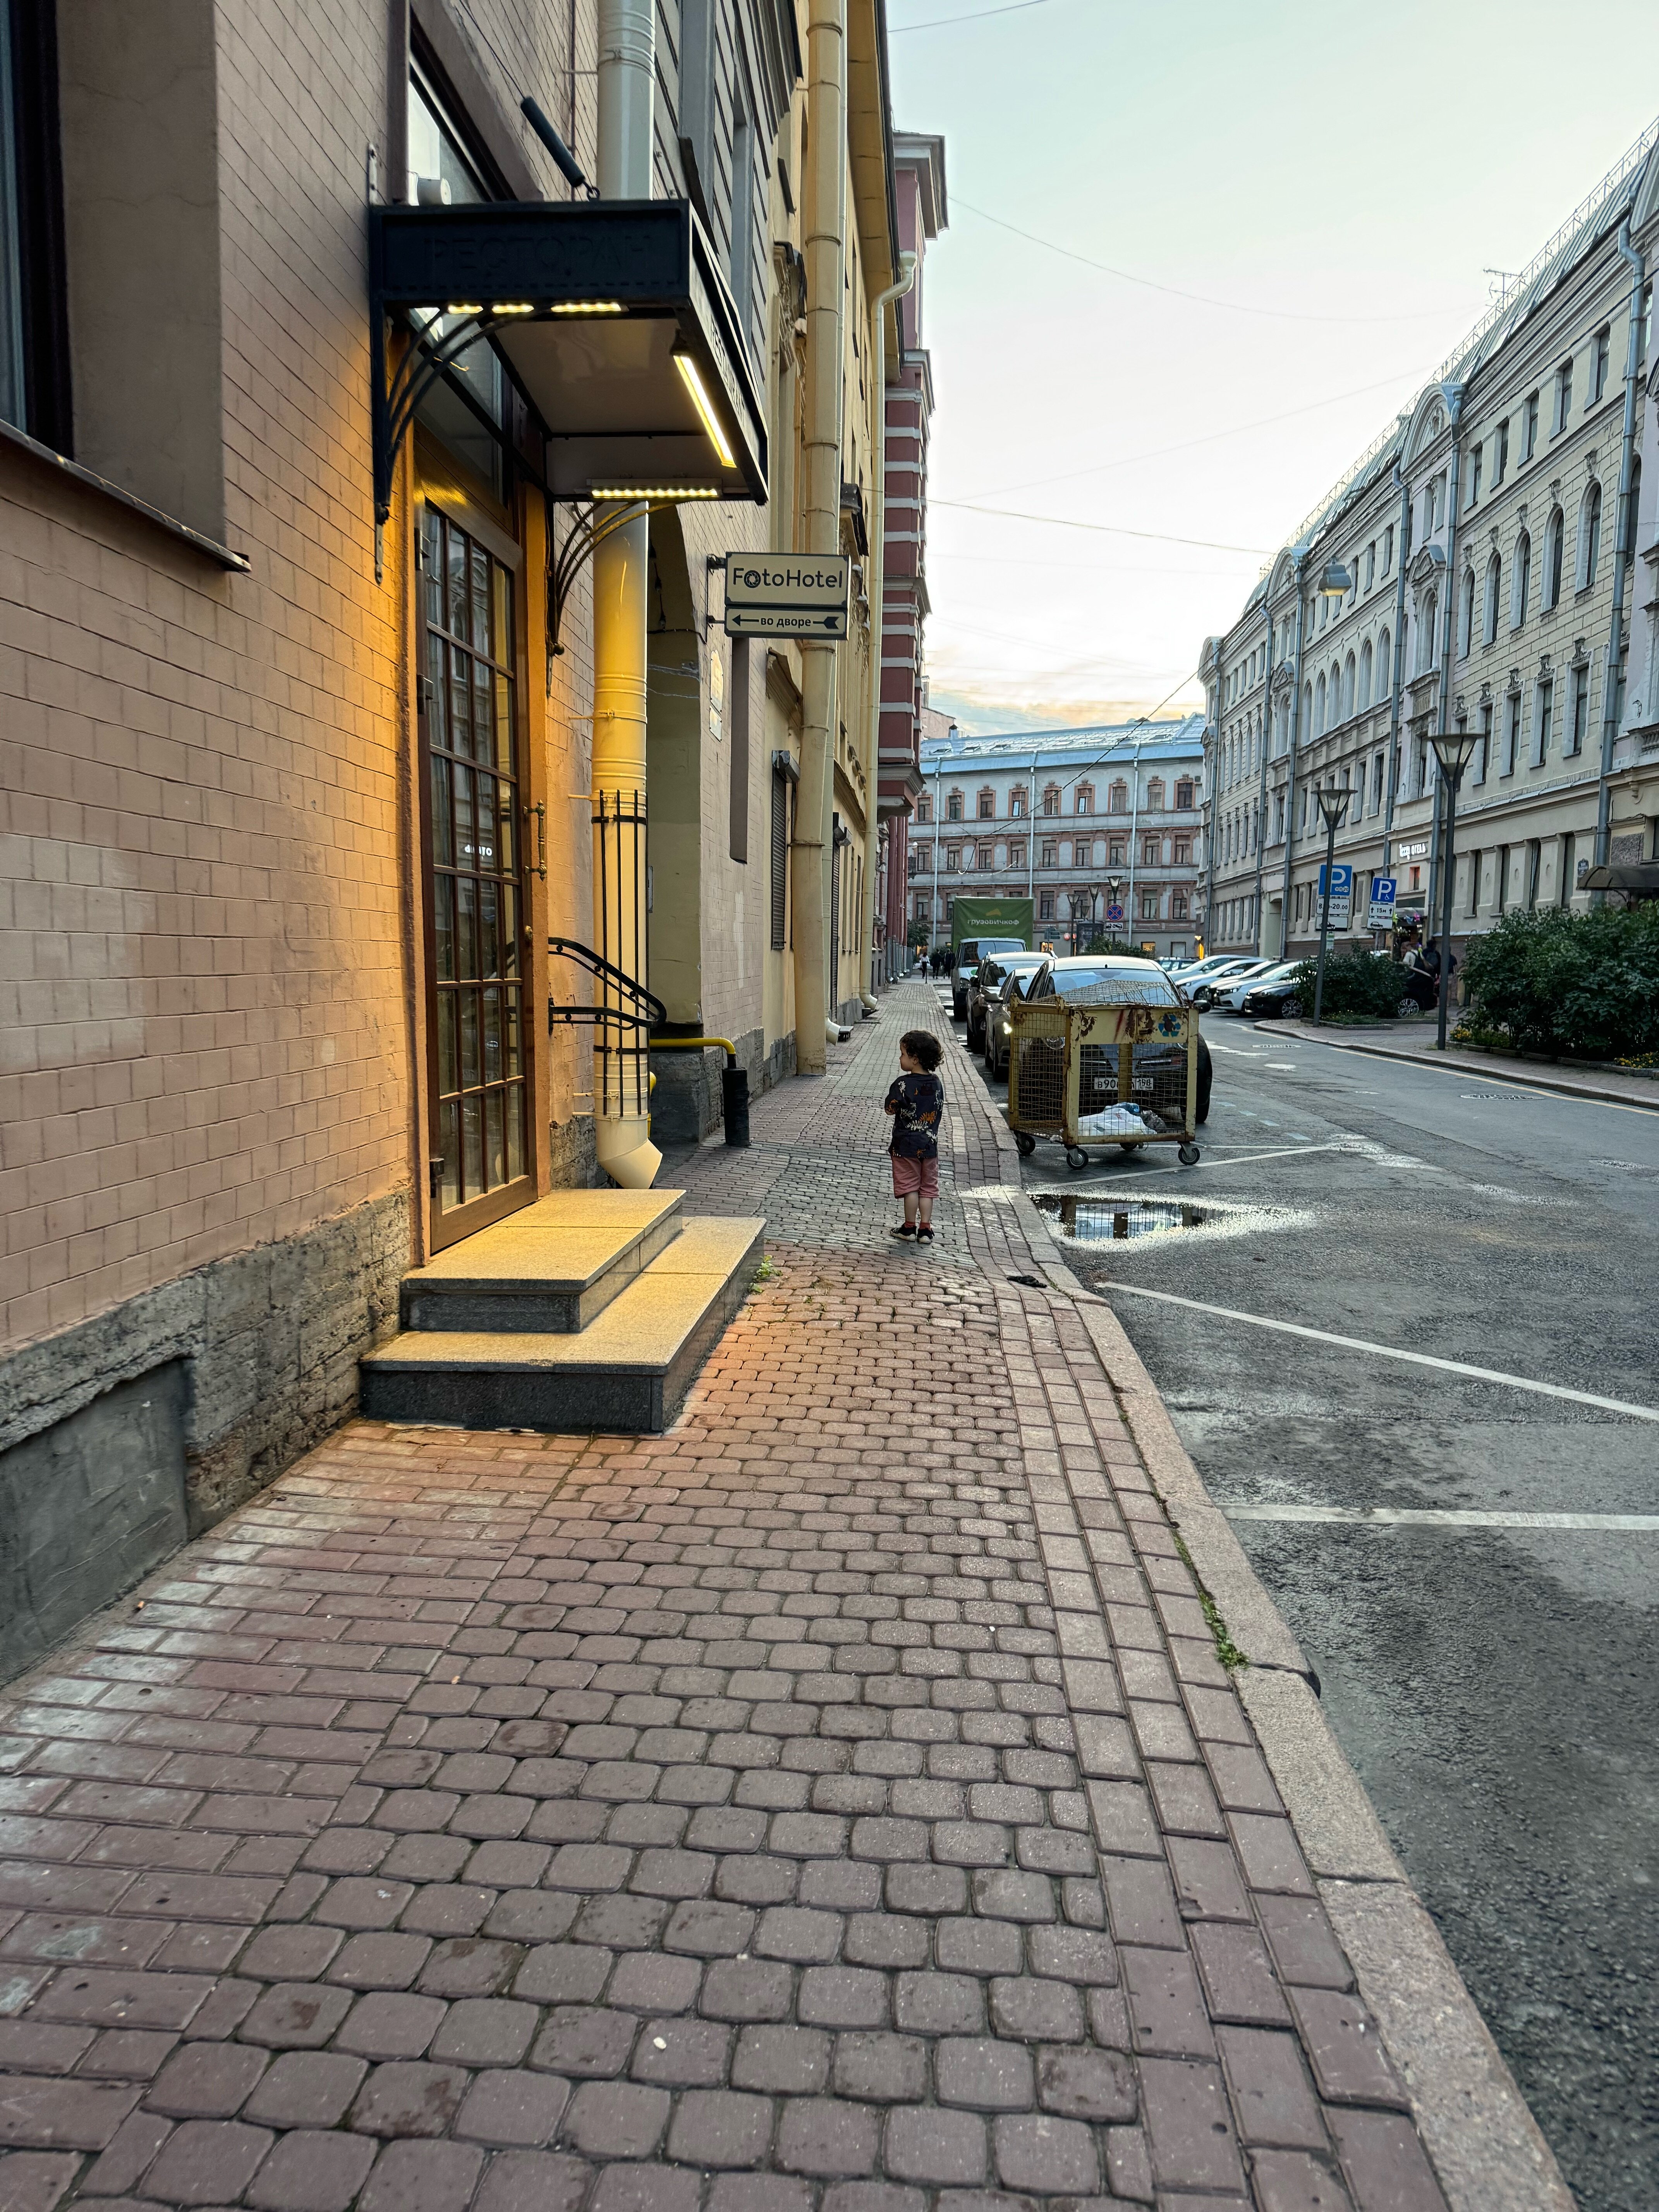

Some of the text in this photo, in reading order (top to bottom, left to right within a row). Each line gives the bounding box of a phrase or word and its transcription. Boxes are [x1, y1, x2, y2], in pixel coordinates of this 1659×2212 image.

[424, 235, 652, 270] РЕСТОРАН
[732, 567, 843, 588] FotoHotel
[760, 618, 811, 628] во дворе
[1330, 868, 1346, 893] P
[1377, 880, 1392, 900] P
